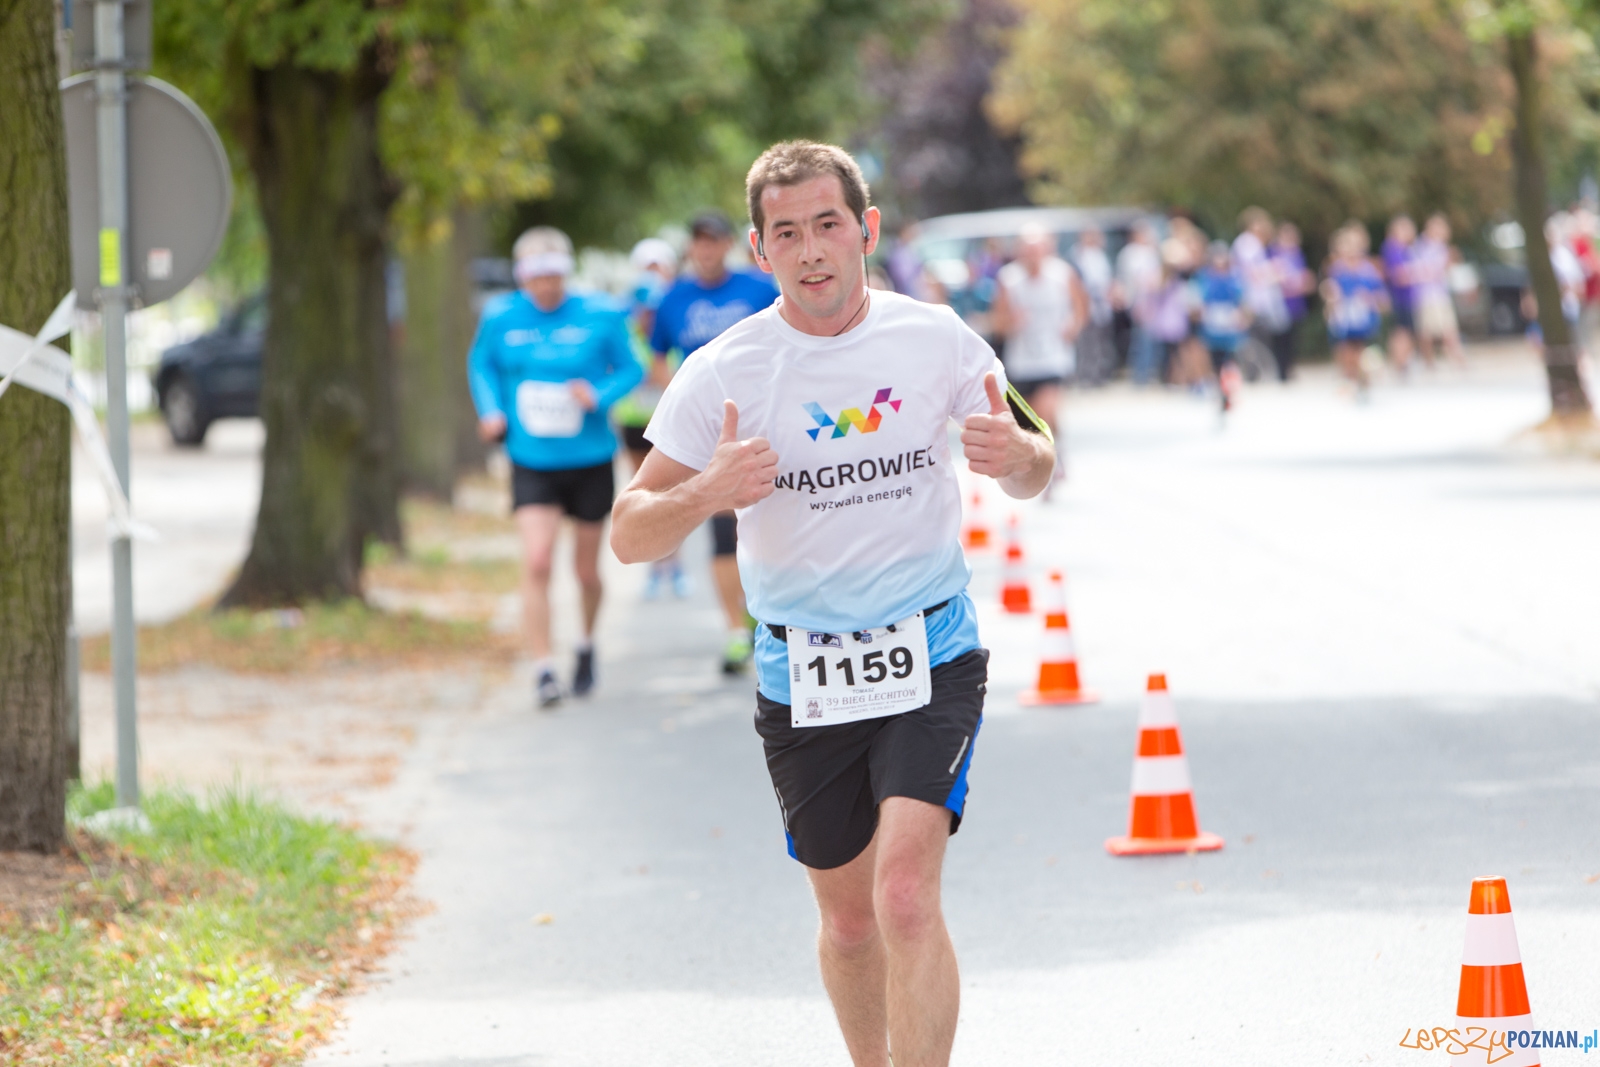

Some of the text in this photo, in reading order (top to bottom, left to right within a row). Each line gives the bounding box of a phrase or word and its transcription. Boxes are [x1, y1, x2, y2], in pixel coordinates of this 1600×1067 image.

[810, 485, 913, 511] wyzwala energię
[808, 646, 913, 686] 1159
[826, 697, 839, 707] 39
[842, 695, 866, 705] BIEG
